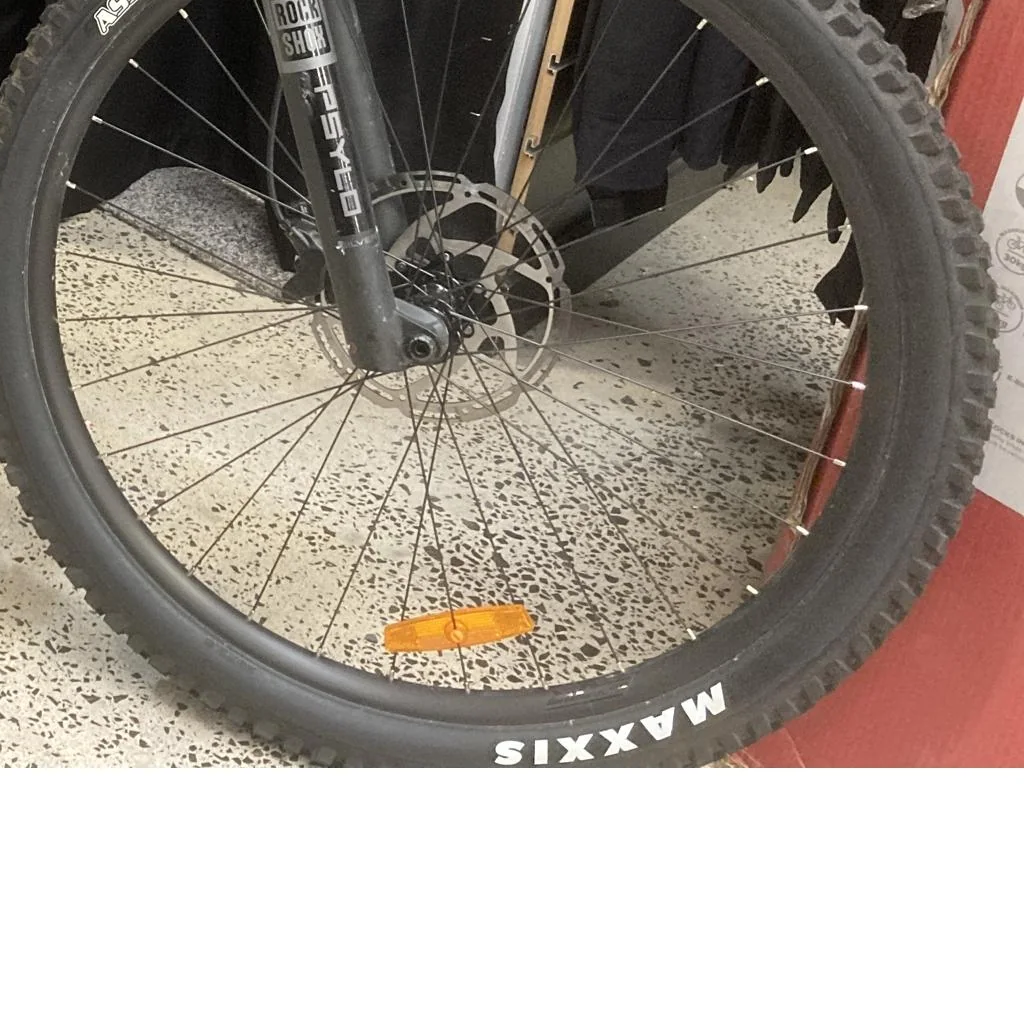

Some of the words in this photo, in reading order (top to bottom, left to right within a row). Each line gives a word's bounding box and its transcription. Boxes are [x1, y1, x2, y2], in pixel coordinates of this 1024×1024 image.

[281, 24, 328, 57] SHOX
[313, 83, 363, 218] PSYLO
[493, 681, 727, 766] MAXXIS
